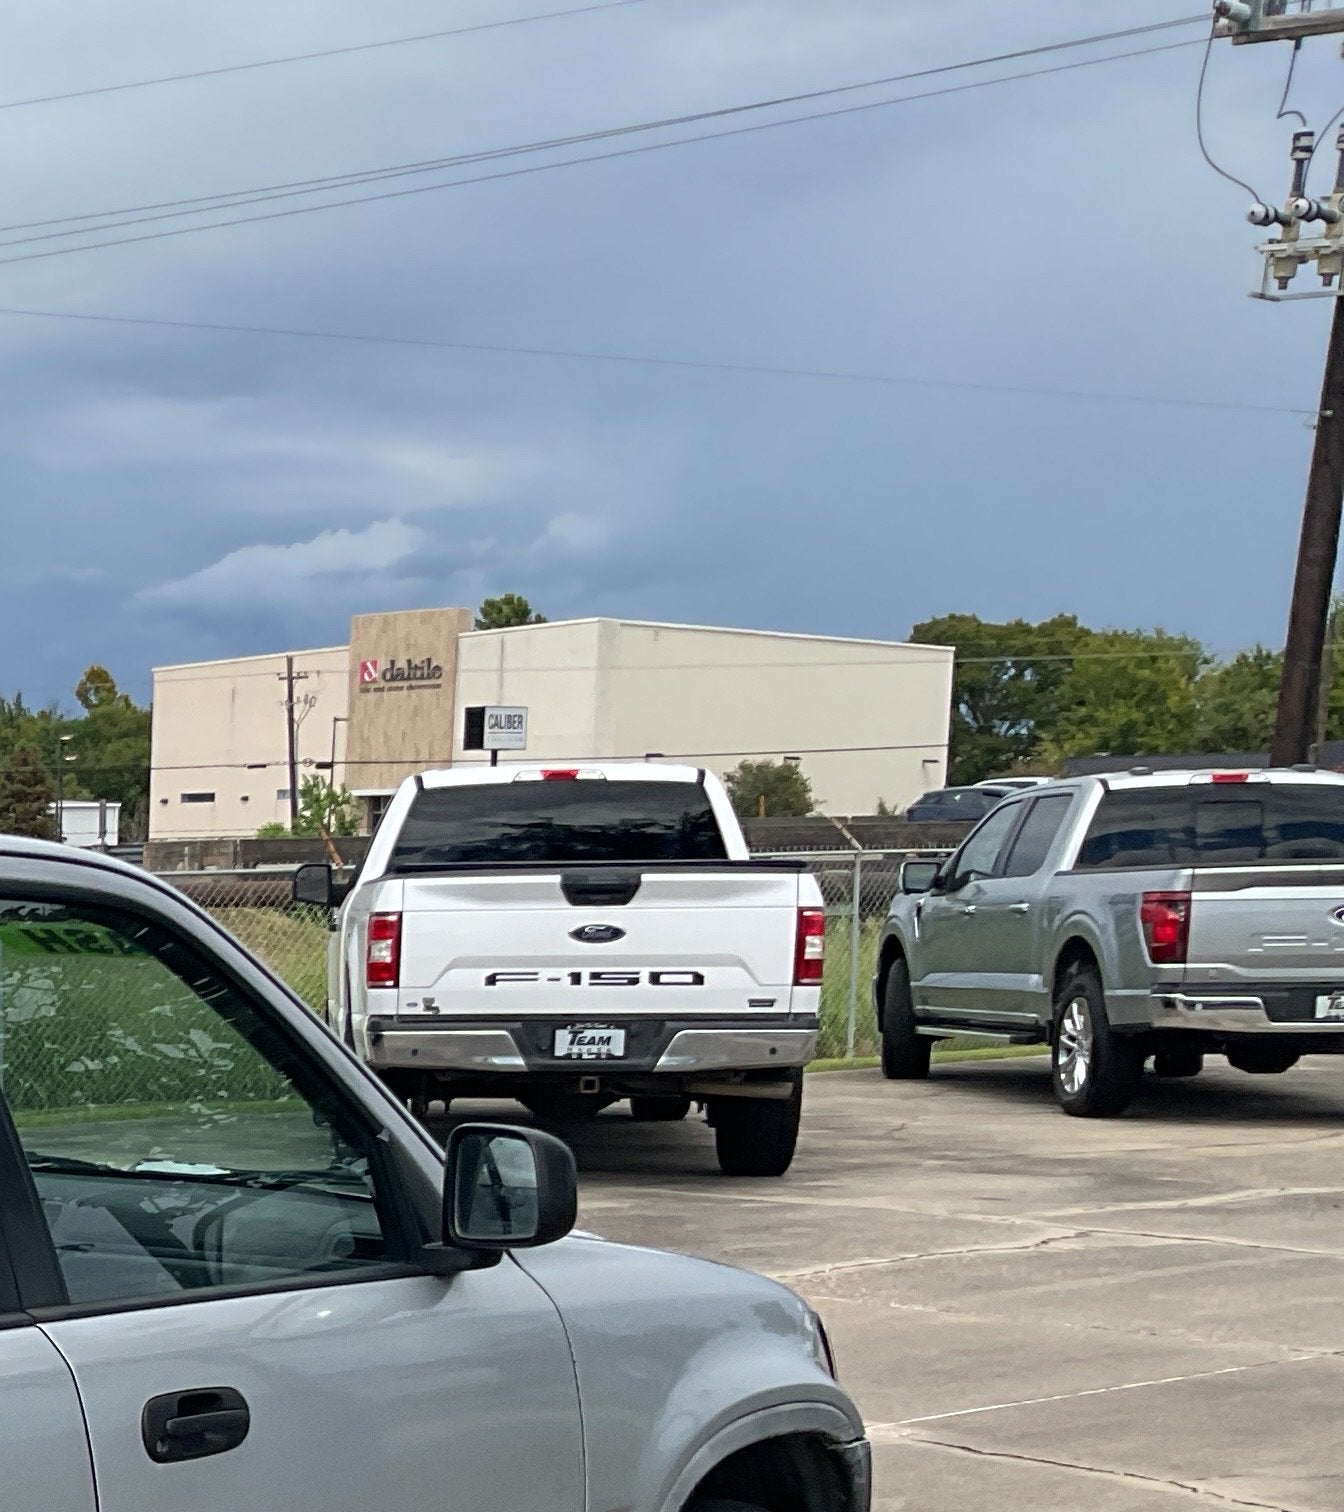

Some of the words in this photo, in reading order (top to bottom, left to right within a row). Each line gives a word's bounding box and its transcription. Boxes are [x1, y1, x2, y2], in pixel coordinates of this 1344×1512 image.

[382, 657, 443, 682] daltile
[488, 714, 523, 729] CALIBER
[484, 971, 704, 986] F-150
[569, 1030, 612, 1045] TEAM
